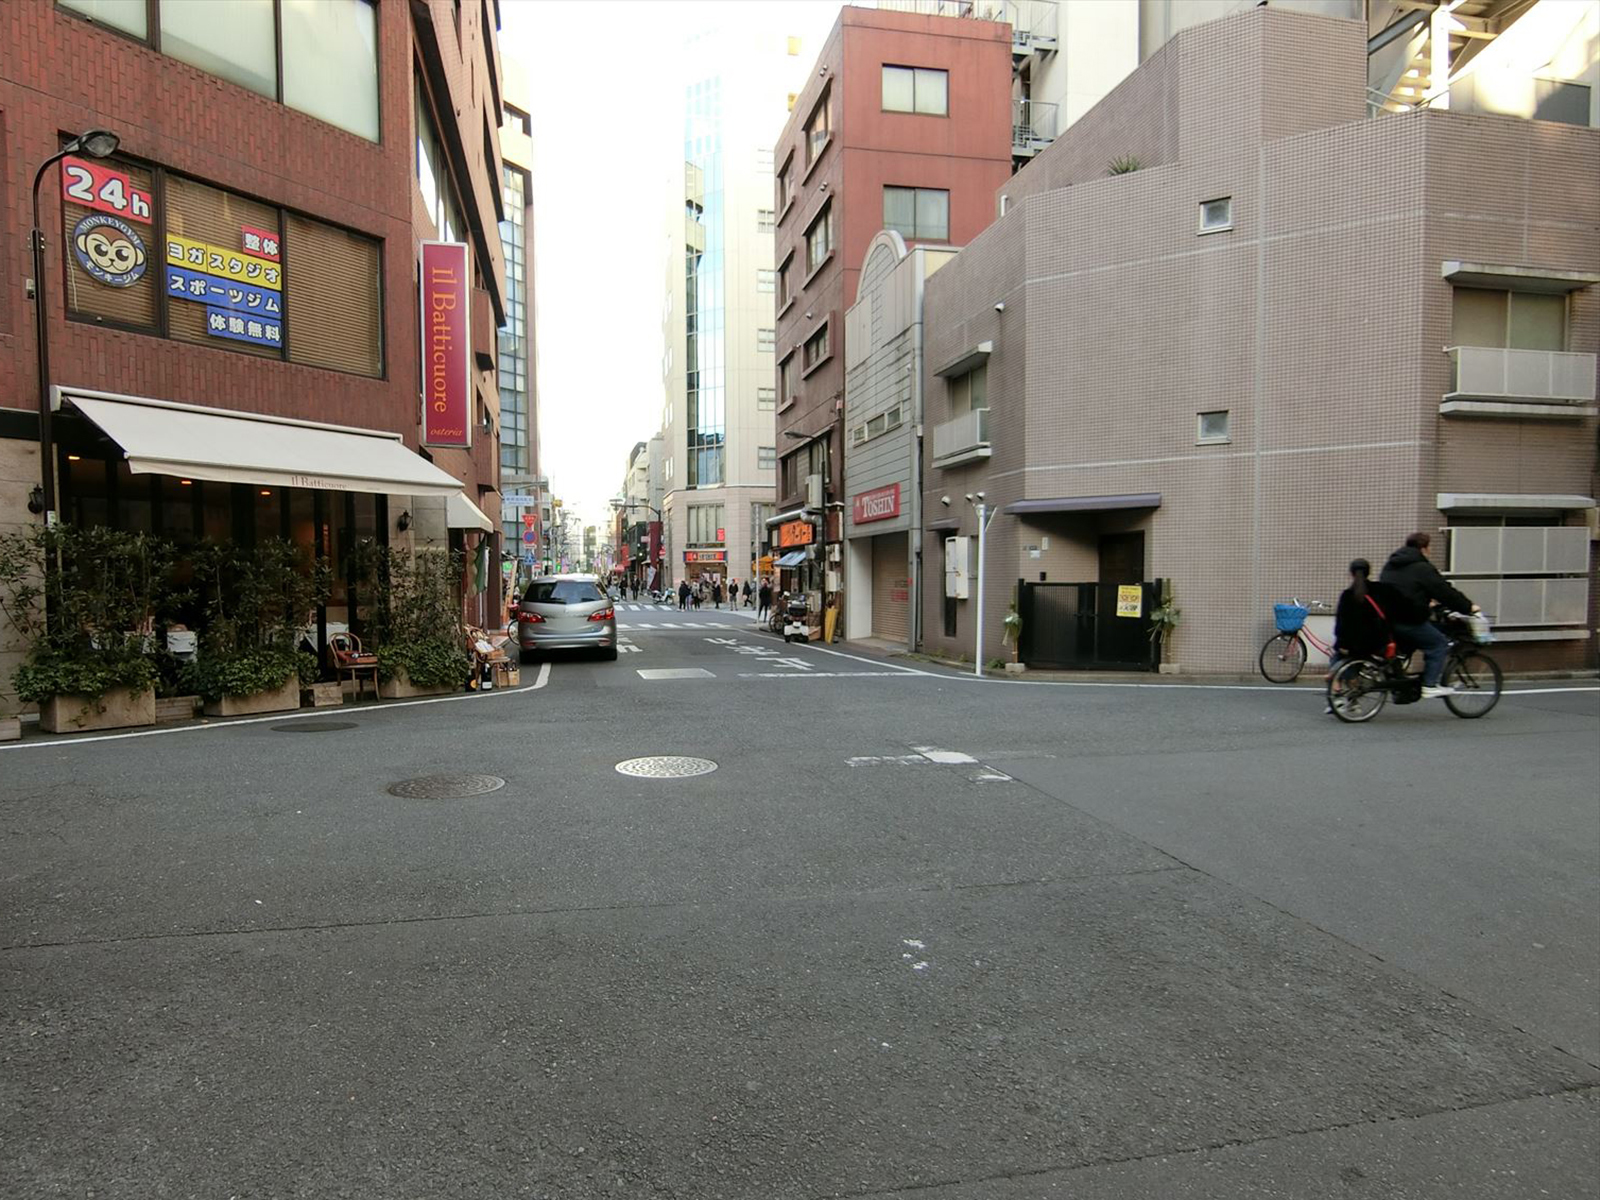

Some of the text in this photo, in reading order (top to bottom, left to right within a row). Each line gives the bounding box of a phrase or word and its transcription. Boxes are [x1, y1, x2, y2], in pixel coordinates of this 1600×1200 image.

[66, 165, 150, 218] 24h
[244, 232, 278, 255] 整体
[86, 260, 139, 283] モンキージム
[168, 242, 279, 284] ヨガスタジオ
[170, 275, 279, 313] スポーツジム
[209, 313, 281, 342] 体験無料
[432, 267, 457, 412] Il Batticuore
[430, 427, 462, 437] osteria
[861, 495, 895, 518] TOSHIN
